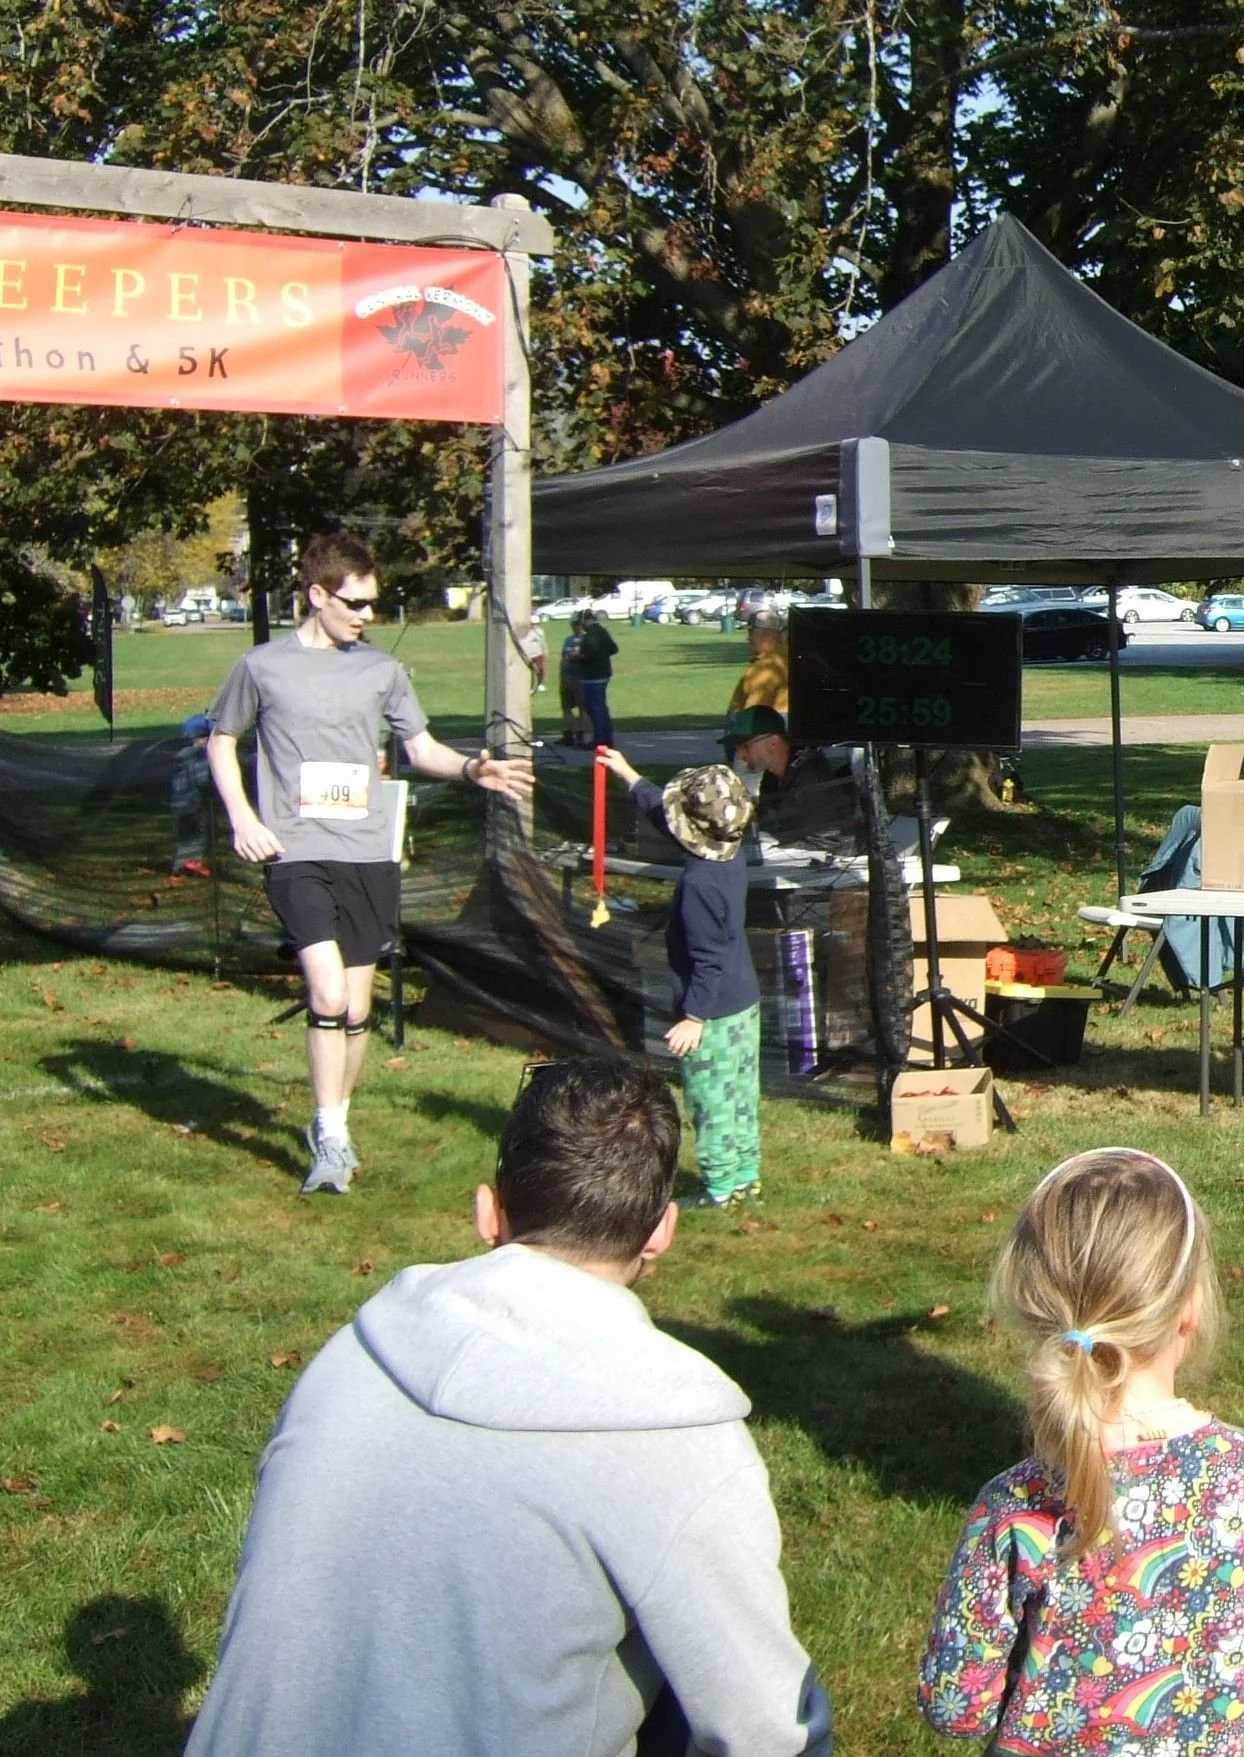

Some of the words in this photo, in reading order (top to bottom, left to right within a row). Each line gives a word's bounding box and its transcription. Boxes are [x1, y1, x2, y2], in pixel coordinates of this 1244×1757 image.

[0, 258, 315, 328] EEPERS
[125, 343, 150, 375] &
[178, 346, 230, 379] 5K
[857, 634, 953, 667] 38:24
[856, 696, 953, 727] 25:59
